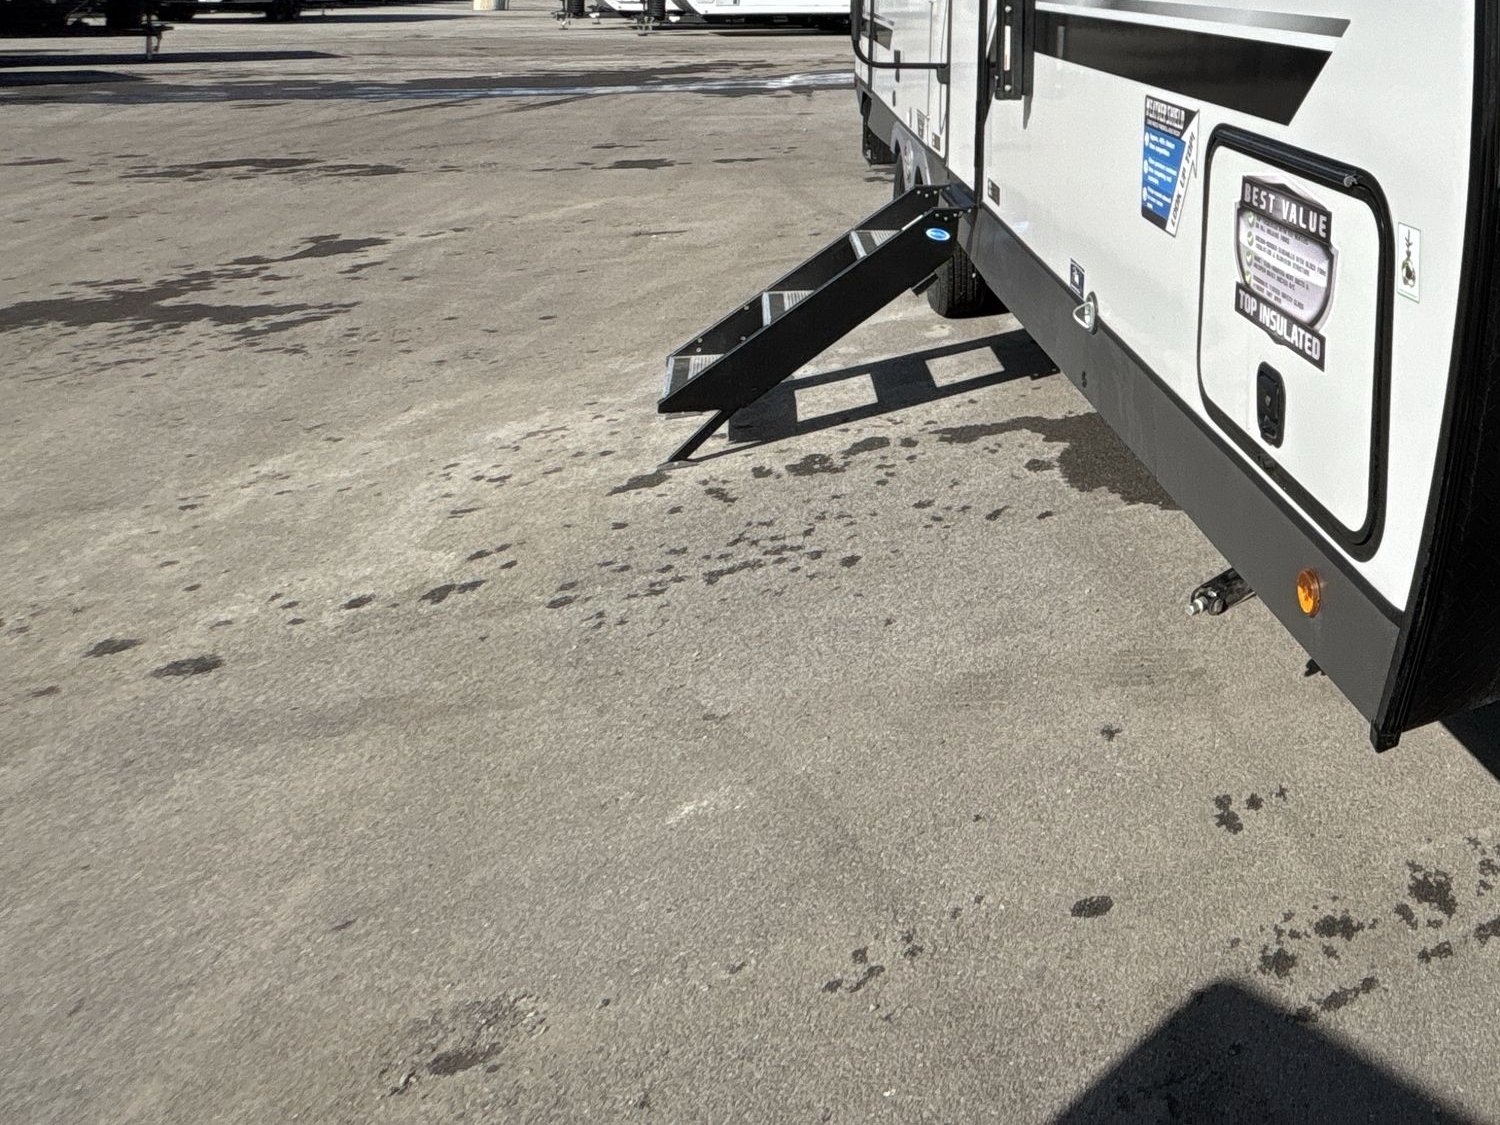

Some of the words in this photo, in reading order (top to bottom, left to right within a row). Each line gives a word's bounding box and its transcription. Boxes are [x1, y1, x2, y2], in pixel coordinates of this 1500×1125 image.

[1243, 182, 1276, 214] BEST
[1281, 199, 1328, 239] VALUE
[1238, 288, 1258, 316] TOP
[1259, 302, 1321, 361] INSULATED
